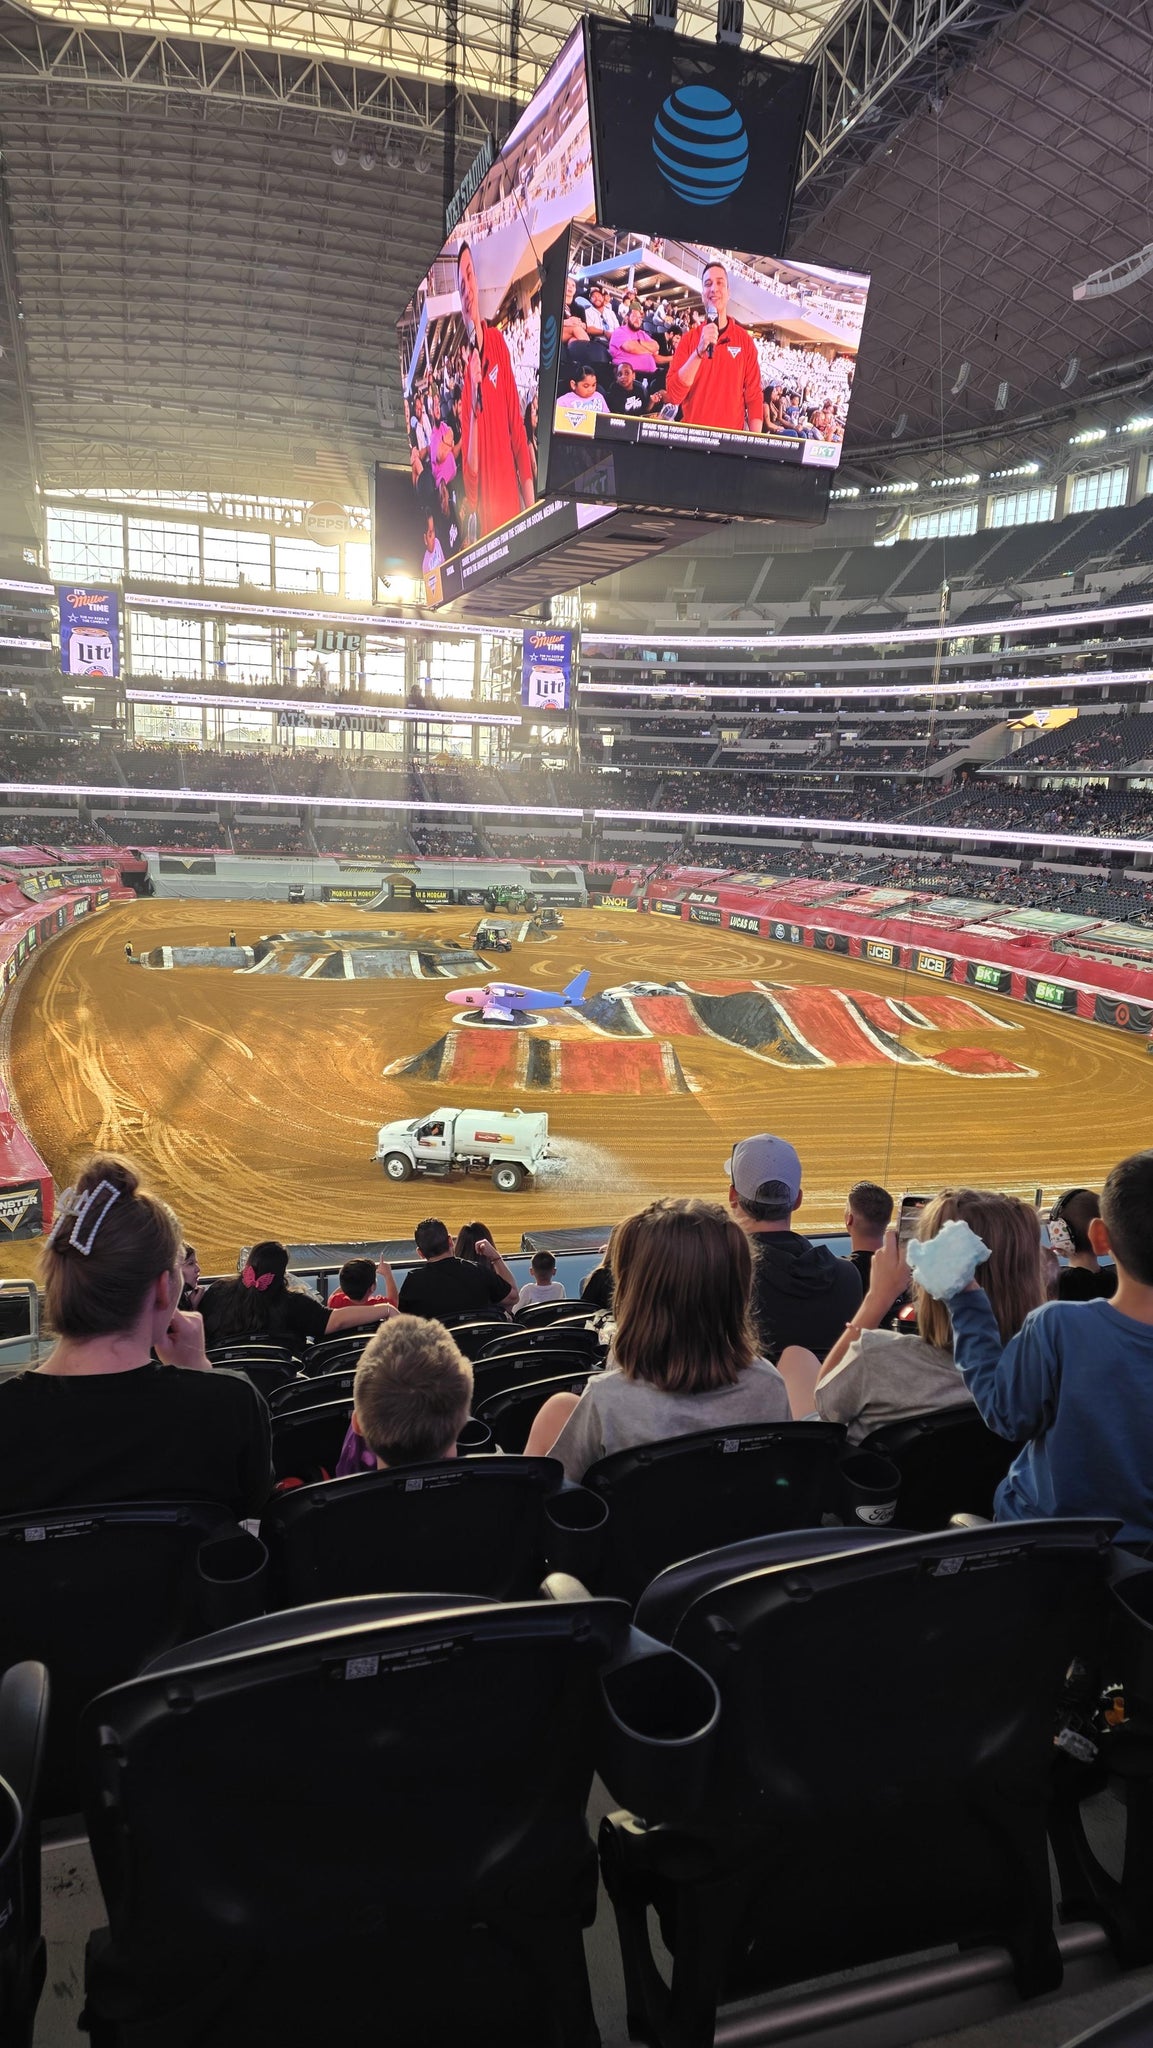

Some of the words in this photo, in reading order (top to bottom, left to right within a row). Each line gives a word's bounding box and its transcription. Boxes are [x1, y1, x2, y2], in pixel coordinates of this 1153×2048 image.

[810, 446, 836, 458] BKT
[308, 516, 348, 531] PEPSI
[66, 594, 110, 608] Miller
[88, 604, 110, 612] TIME
[314, 629, 360, 655] Lite
[530, 634, 566, 649] Miller
[76, 642, 111, 664] Lite
[536, 678, 564, 698] Lite
[278, 712, 317, 728] AT&T
[321, 716, 389, 732] STADIUM
[602, 896, 628, 906] UNOH
[730, 916, 748, 929] LUCAS
[748, 920, 760, 932] OIL
[869, 945, 891, 960] JCB
[920, 958, 944, 973] JCB
[976, 966, 1001, 984] BKT
[1036, 982, 1065, 1004] BKT
[0, 1207, 24, 1218] JAM
